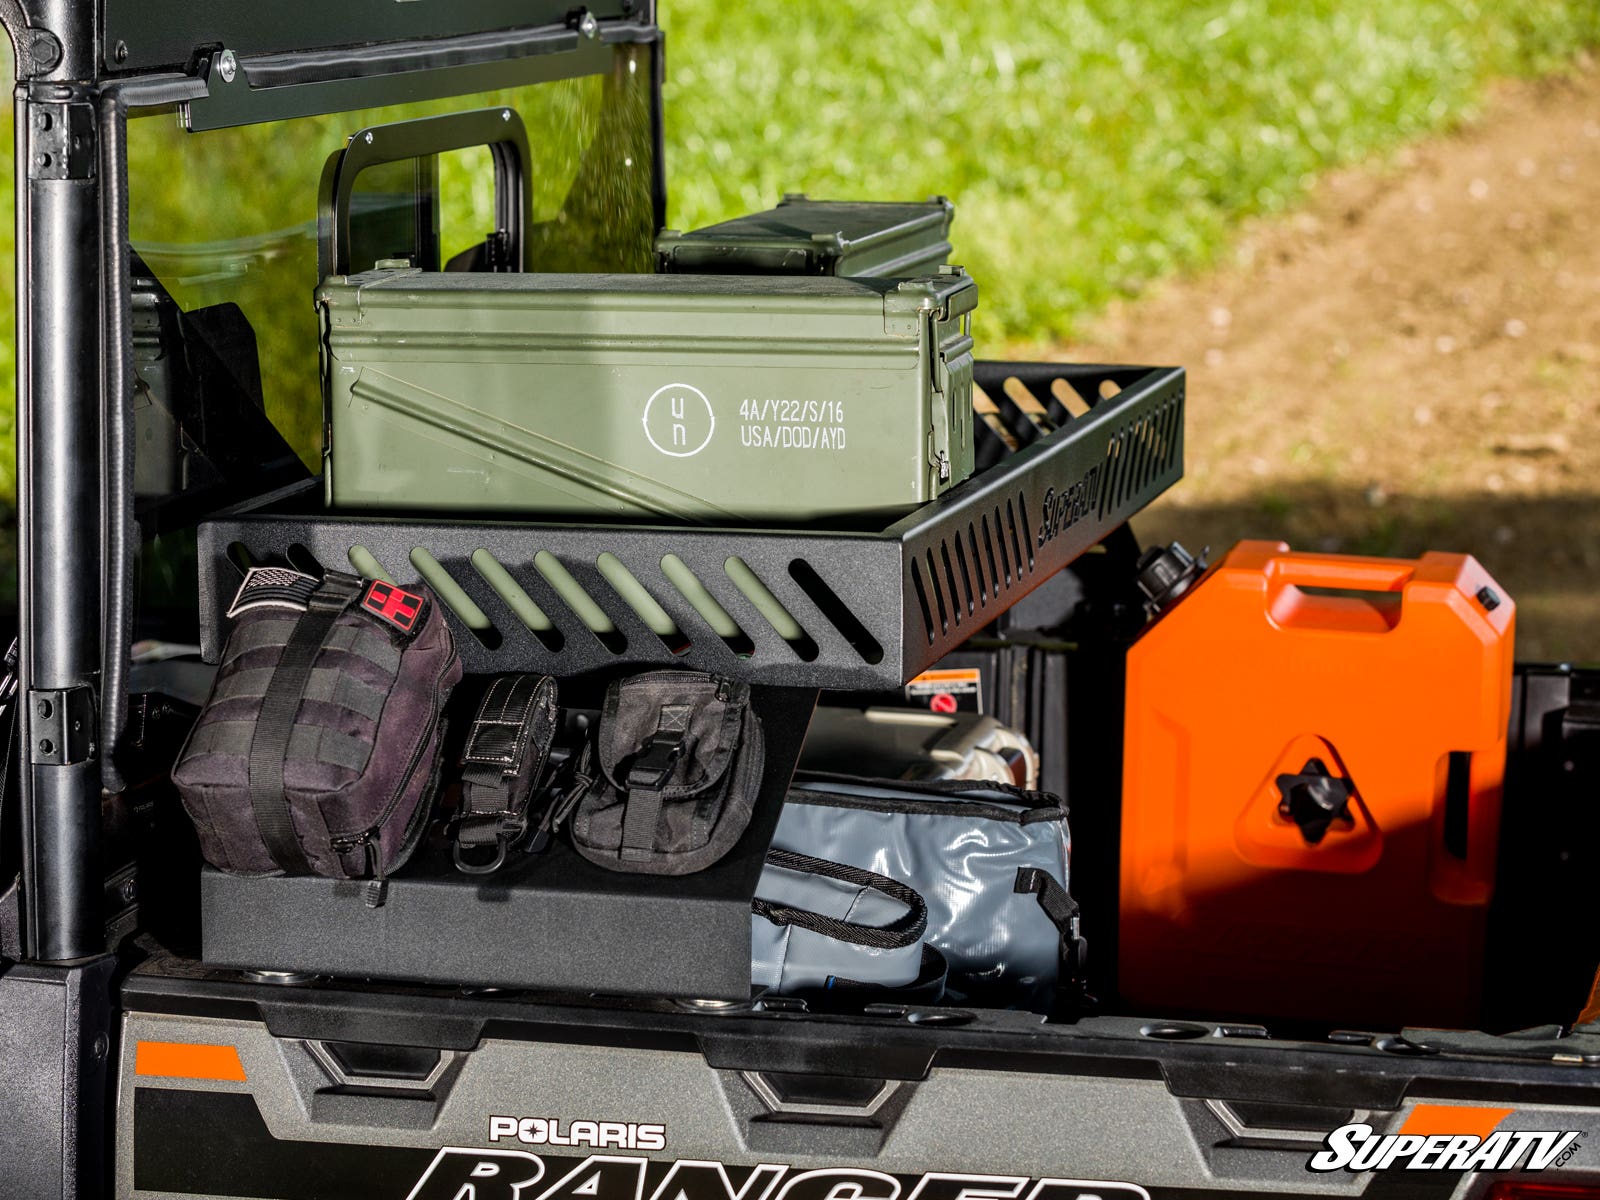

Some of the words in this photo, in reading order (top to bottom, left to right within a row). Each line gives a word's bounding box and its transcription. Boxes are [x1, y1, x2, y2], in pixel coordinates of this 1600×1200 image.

[739, 399, 844, 423] 4A/Y22/S/16
[740, 425, 846, 449] USA/DOD/AYD
[489, 1115, 667, 1151] POLARIS
